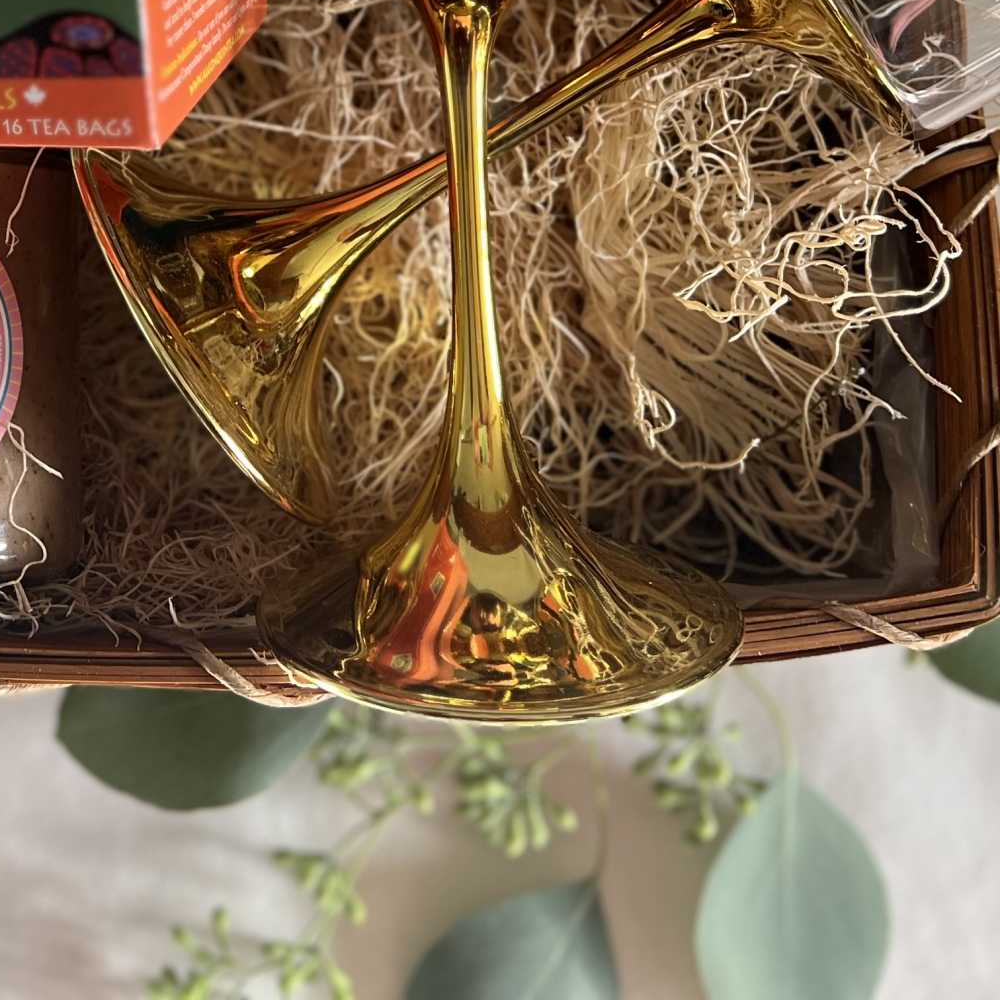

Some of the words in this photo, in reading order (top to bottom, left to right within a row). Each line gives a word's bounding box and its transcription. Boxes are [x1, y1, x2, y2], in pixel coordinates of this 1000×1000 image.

[2, 118, 23, 136] 16
[27, 118, 71, 136] TEA
[76, 119, 133, 137] BAGS
